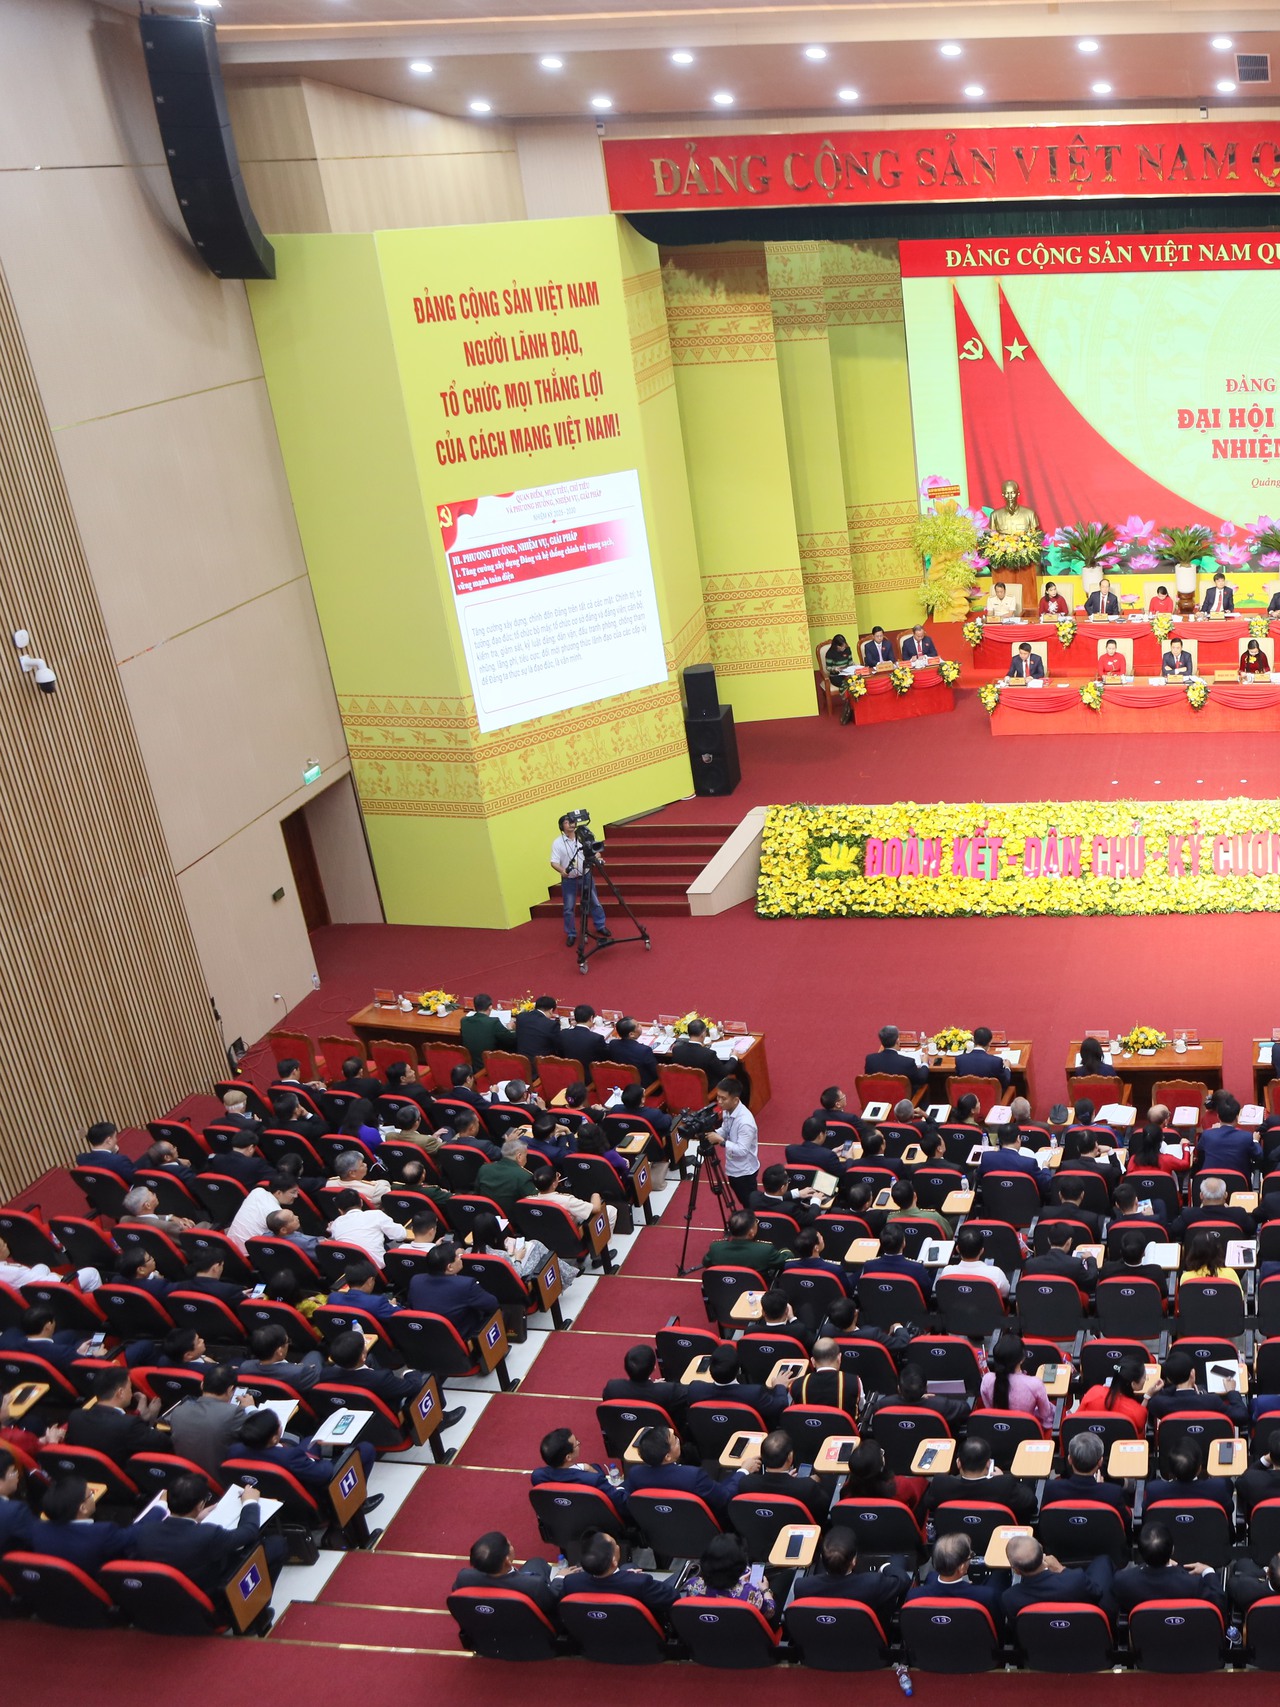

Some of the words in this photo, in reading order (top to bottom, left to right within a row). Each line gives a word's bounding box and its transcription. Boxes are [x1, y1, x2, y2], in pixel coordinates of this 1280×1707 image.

[650, 142, 771, 196] ĐẢNG
[783, 139, 904, 199] CỘNG
[916, 132, 999, 188] SẢN
[1011, 134, 1122, 191] VIỆT
[1136, 141, 1240, 182] NAM
[945, 243, 1010, 268] ĐẢNG
[1016, 243, 1083, 269] CỘNG
[1089, 240, 1132, 263] SẢN
[1138, 239, 1193, 267] VIỆT
[1199, 243, 1251, 262] NAM
[413, 287, 457, 324] ĐẢNG
[460, 287, 500, 324] CỘNG
[503, 280, 533, 315] SẢN
[535, 281, 564, 316] VIỆT
[568, 281, 600, 309] NAM
[463, 332, 509, 367] NGƯỜI
[512, 330, 549, 361] LÃNH
[551, 329, 583, 360] ĐẠO,
[440, 380, 460, 417] TỔ
[463, 381, 501, 414] CHỨC
[504, 381, 533, 412] MỌI
[535, 368, 579, 404] THẮNG
[582, 370, 603, 401] LỢI
[1226, 375, 1276, 393] ĐẢNG
[436, 430, 467, 465] CỦA
[469, 428, 508, 460] CÁCH
[510, 424, 552, 457] MẠNG
[554, 416, 582, 449] VIỆT
[585, 413, 621, 442] NAM!
[1178, 408, 1221, 433] ĐẠI
[1228, 403, 1274, 432] HỘI
[865, 827, 942, 877] ĐOÀN
[952, 820, 1000, 881] KẾT
[1024, 827, 1082, 880] DÂN
[1092, 821, 1145, 877] CHỦ
[1168, 819, 1205, 877] KỶ
